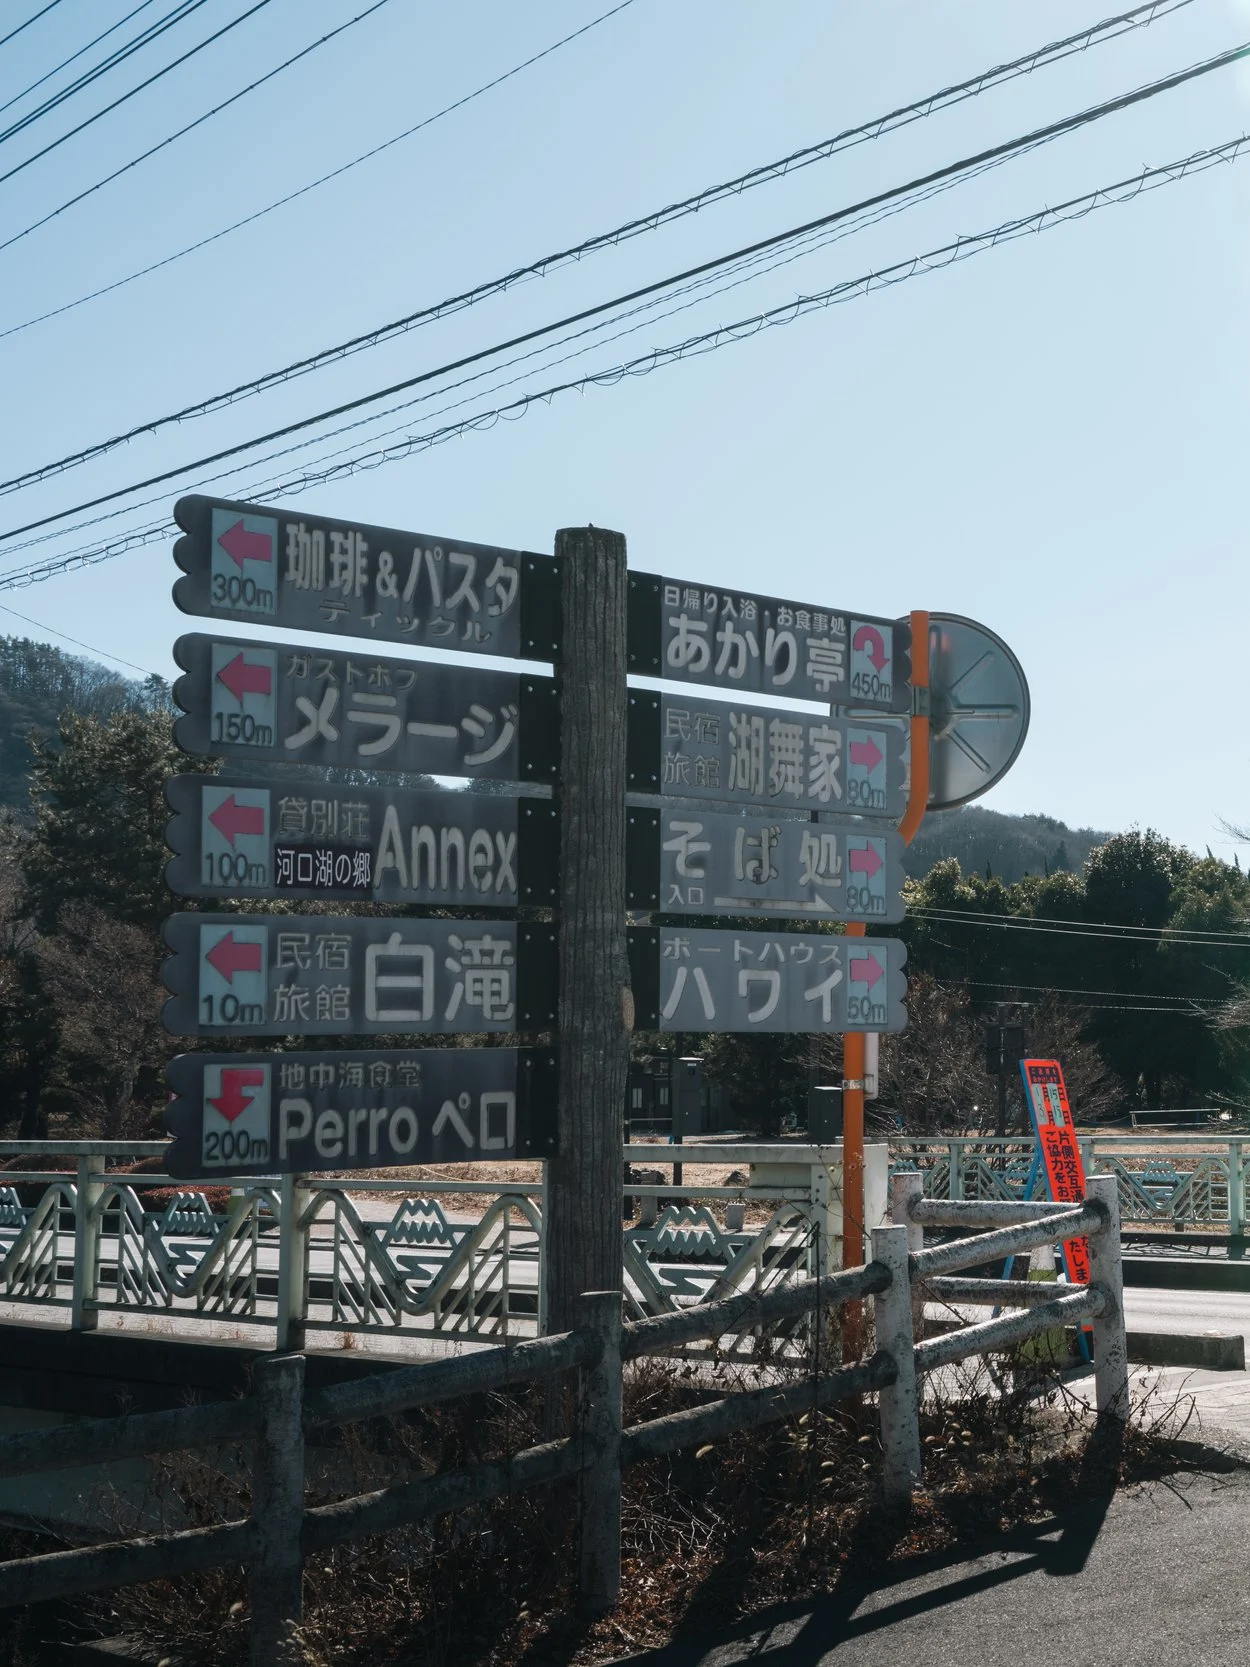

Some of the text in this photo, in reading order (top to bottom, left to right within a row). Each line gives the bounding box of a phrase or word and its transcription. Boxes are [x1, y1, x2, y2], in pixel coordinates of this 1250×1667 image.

[285, 522, 520, 617] 珈琲&パスタ
[211, 572, 275, 610] 300m
[285, 653, 417, 690] ガストホフ
[666, 613, 846, 693] あかり亭
[851, 671, 892, 699] 450m
[214, 711, 273, 746] 150m
[284, 687, 519, 766] メラージ
[665, 707, 721, 746] 民宿
[664, 752, 721, 790] 旅館
[728, 711, 843, 801] 湖舞家
[848, 778, 886, 811] 80m
[278, 796, 370, 840] 貸別荘
[204, 851, 268, 884] 100m
[275, 848, 372, 889] 河口湖の郷
[373, 804, 518, 896] Annex
[662, 820, 843, 888] そば処
[667, 884, 704, 905] 入口
[846, 885, 886, 912] 80m
[275, 932, 352, 970] 民宿
[662, 936, 843, 965] ボートハウス
[364, 931, 516, 1023] 白滝
[662, 966, 844, 1024] ハワイ
[202, 993, 266, 1025] 10m
[273, 983, 351, 1023] 旅館
[847, 995, 886, 1022] 50m
[280, 1060, 421, 1090] 地中海食堂
[278, 1091, 517, 1161] Perro ペロ
[203, 1129, 269, 1162] 200m
